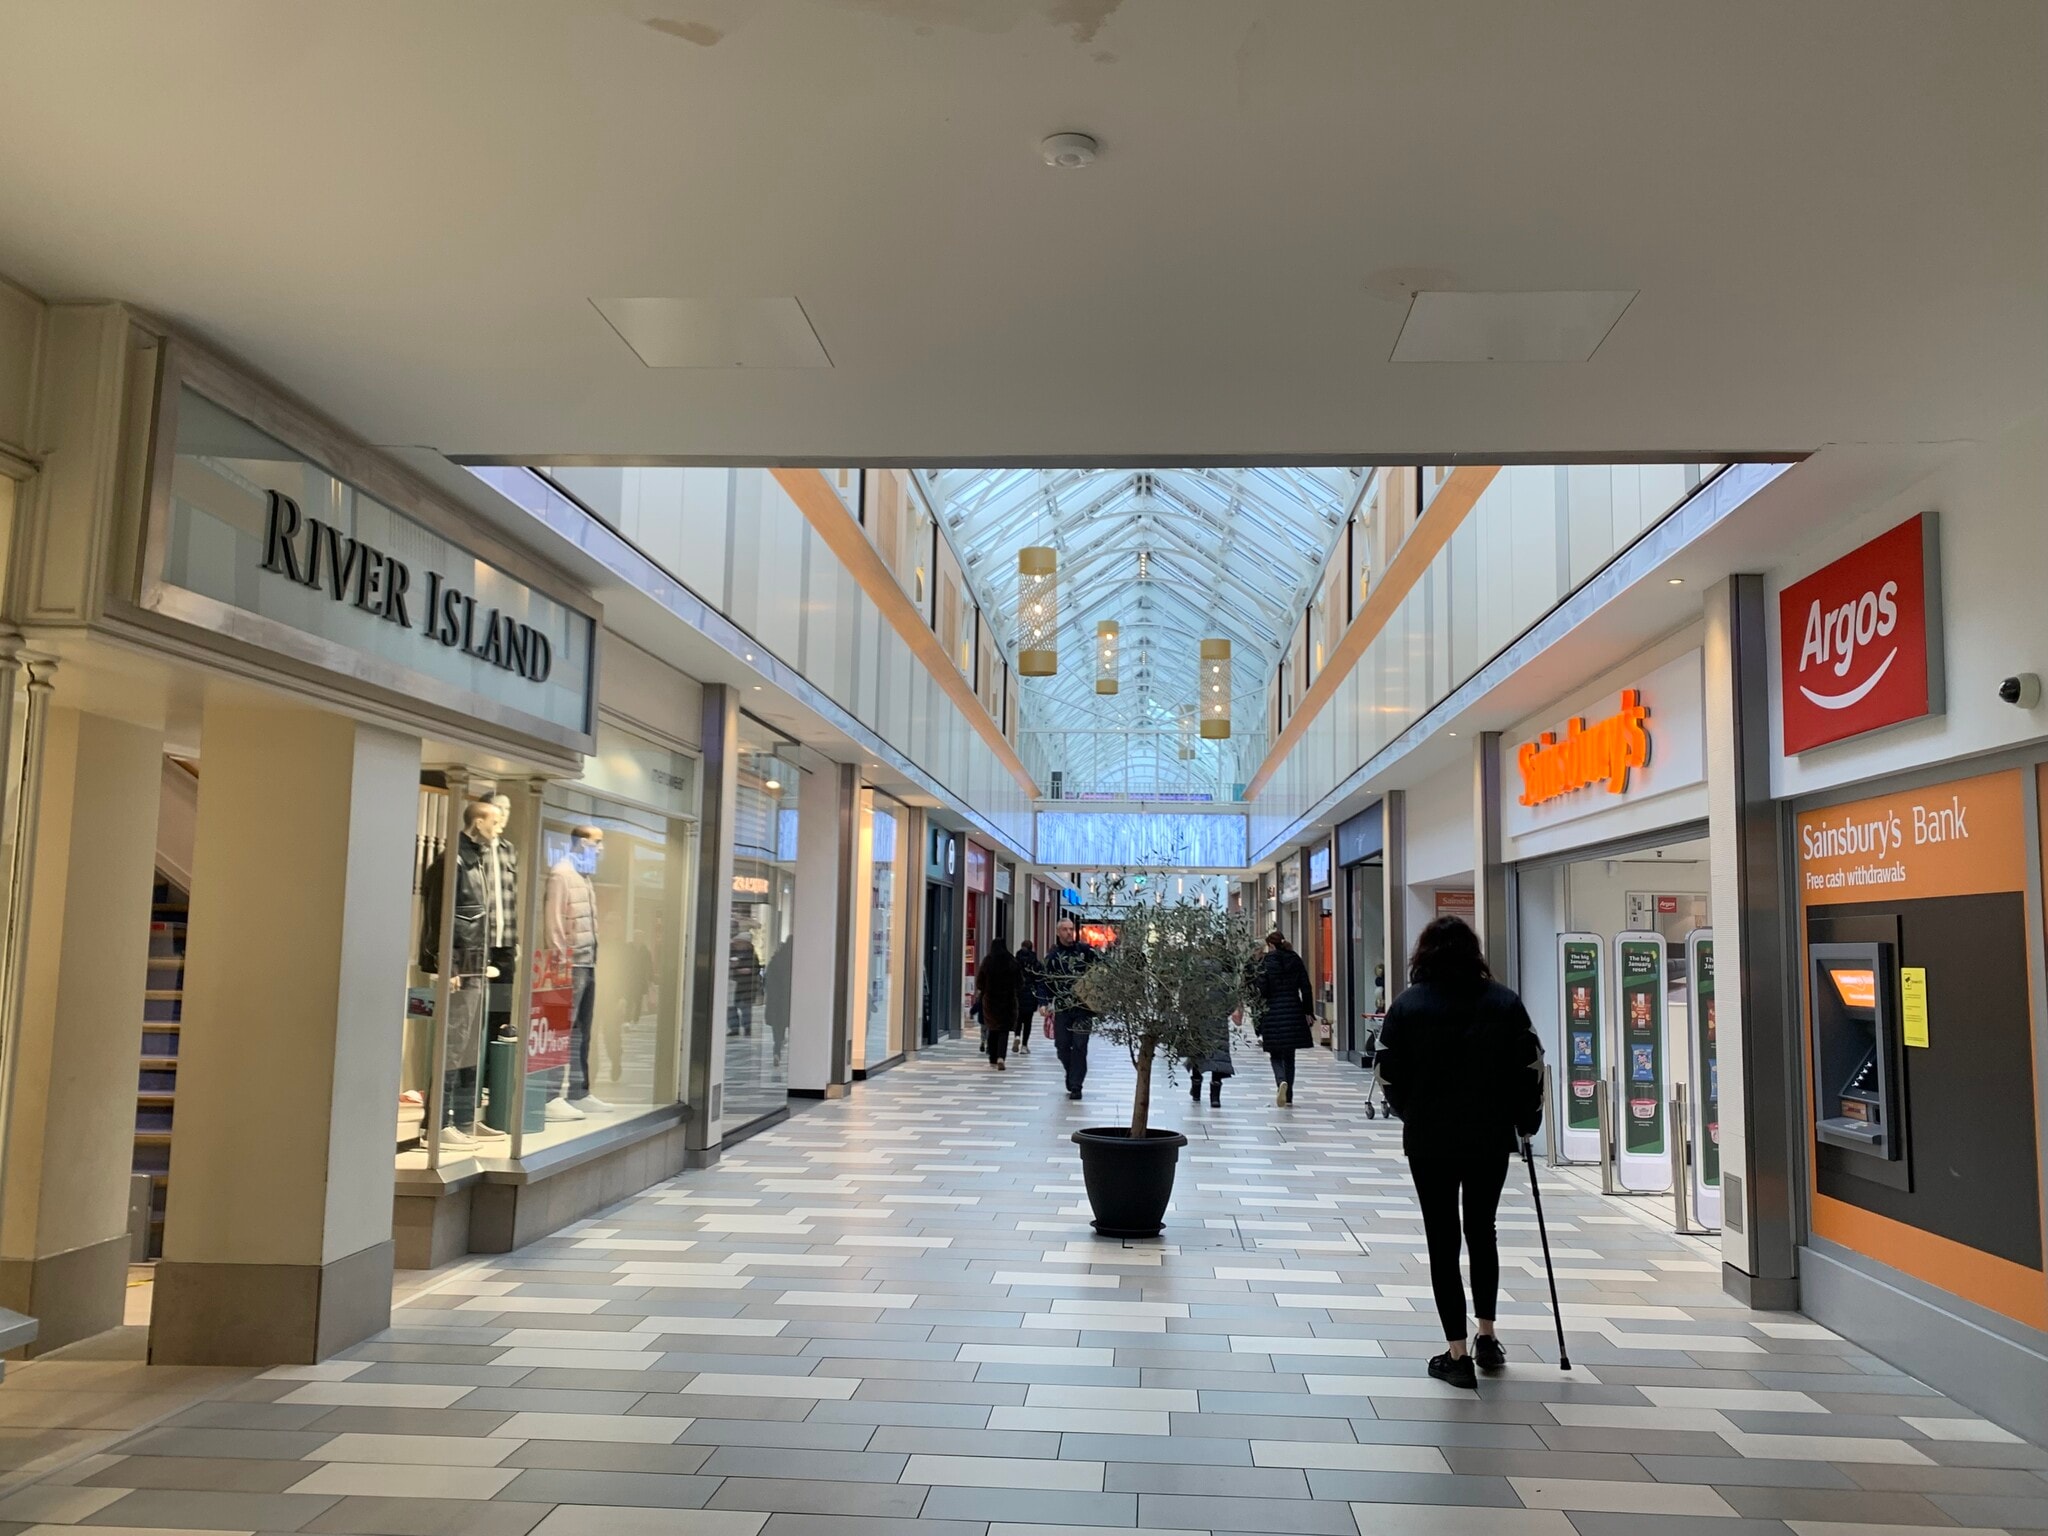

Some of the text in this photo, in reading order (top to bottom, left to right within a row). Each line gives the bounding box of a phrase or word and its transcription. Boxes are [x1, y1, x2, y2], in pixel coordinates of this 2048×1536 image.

[257, 488, 552, 683] RIVER ISLAND
[1799, 580, 1898, 677] Argos
[1803, 795, 1969, 861] Sainsbury's Bank
[1806, 861, 1906, 889] Free cash withdrawals
